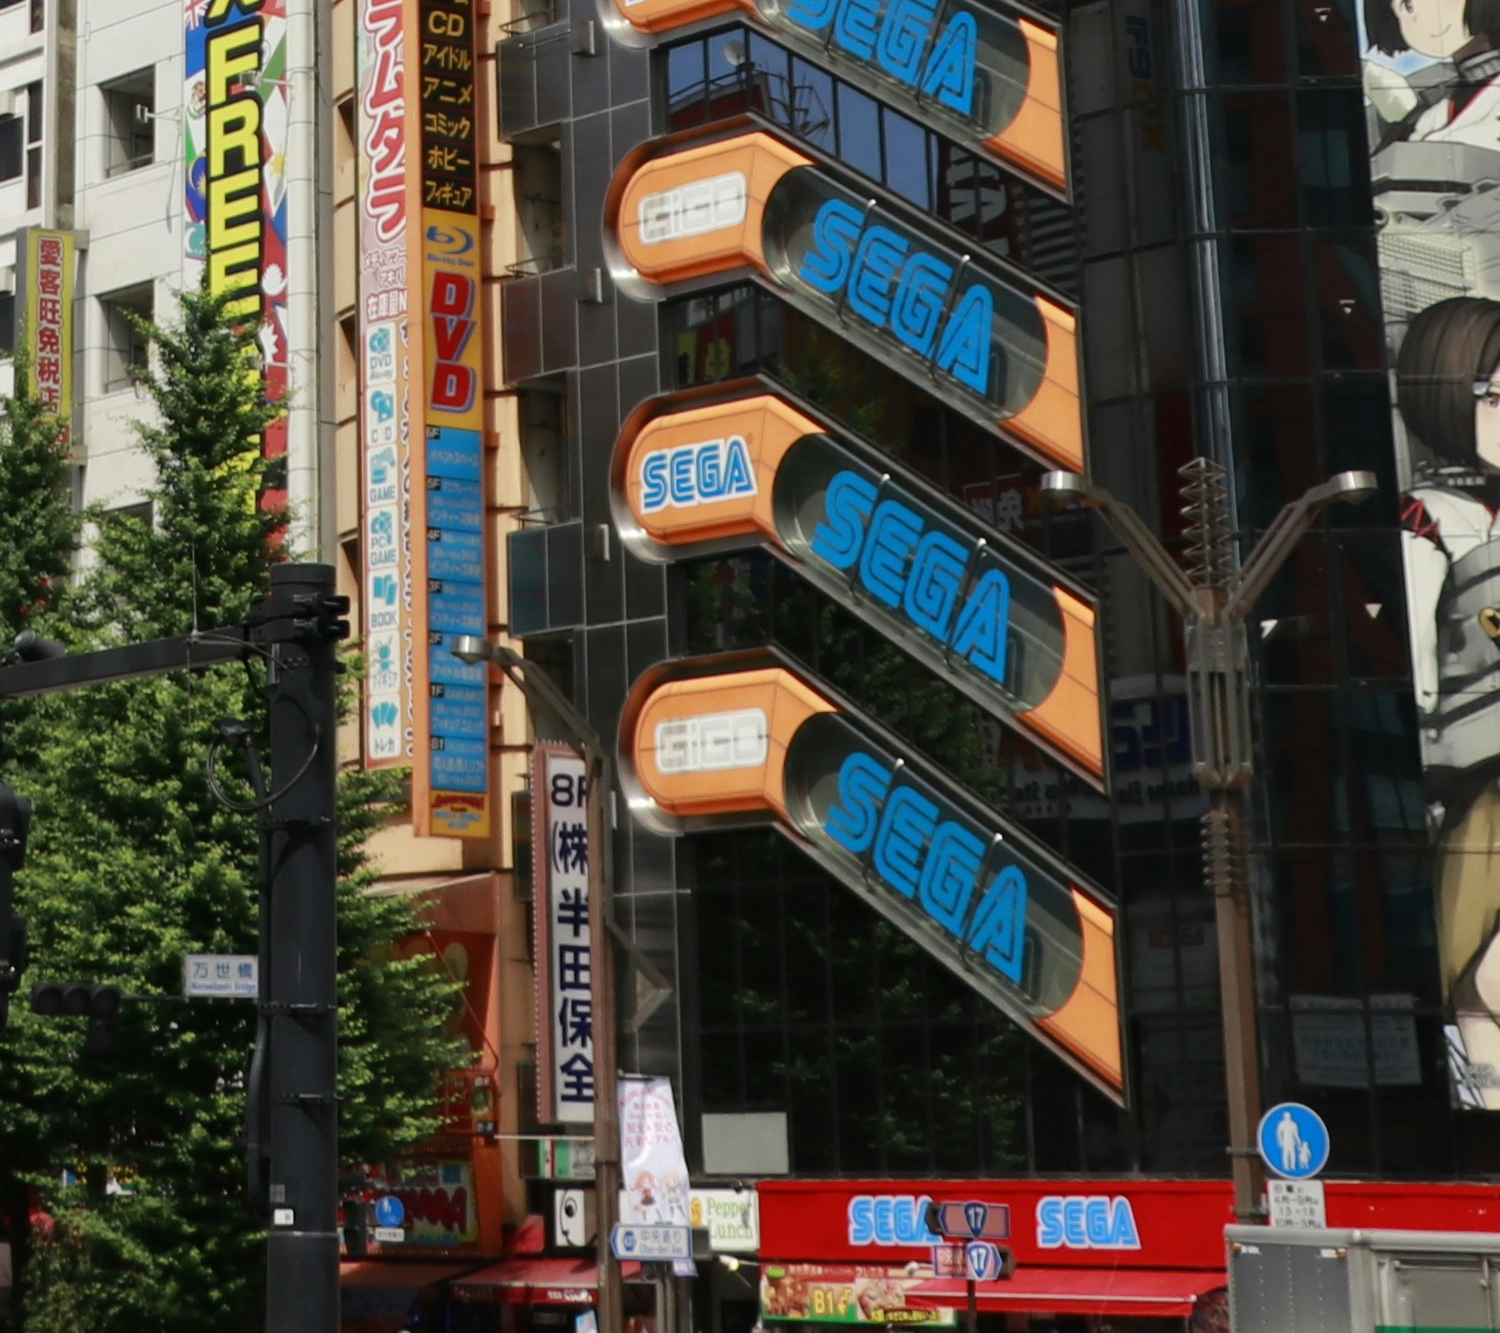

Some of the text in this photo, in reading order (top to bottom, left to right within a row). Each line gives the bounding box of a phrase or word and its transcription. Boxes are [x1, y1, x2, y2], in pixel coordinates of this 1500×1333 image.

[428, 11, 464, 37] CD
[423, 42, 472, 72] アイドル
[423, 77, 473, 104] アニメ
[424, 111, 471, 139] コミック
[427, 147, 471, 171] ホビー
[424, 179, 472, 207] フィギュア
[802, 198, 995, 395] SEGA
[430, 271, 477, 413] DVD
[370, 354, 392, 369] DVD
[642, 437, 757, 512] SEGA
[370, 488, 397, 502] GAME
[370, 536, 388, 550] PC
[370, 549, 397, 566] GAME
[812, 470, 1010, 685] SEGA
[371, 612, 398, 628] BOOK
[826, 752, 1028, 983] SEGA
[192, 961, 254, 979] 万世橋
[849, 1197, 943, 1245] SEGA
[968, 1206, 985, 1230] 17
[1038, 1198, 1139, 1248] SEGA
[972, 1246, 988, 1270] 17
